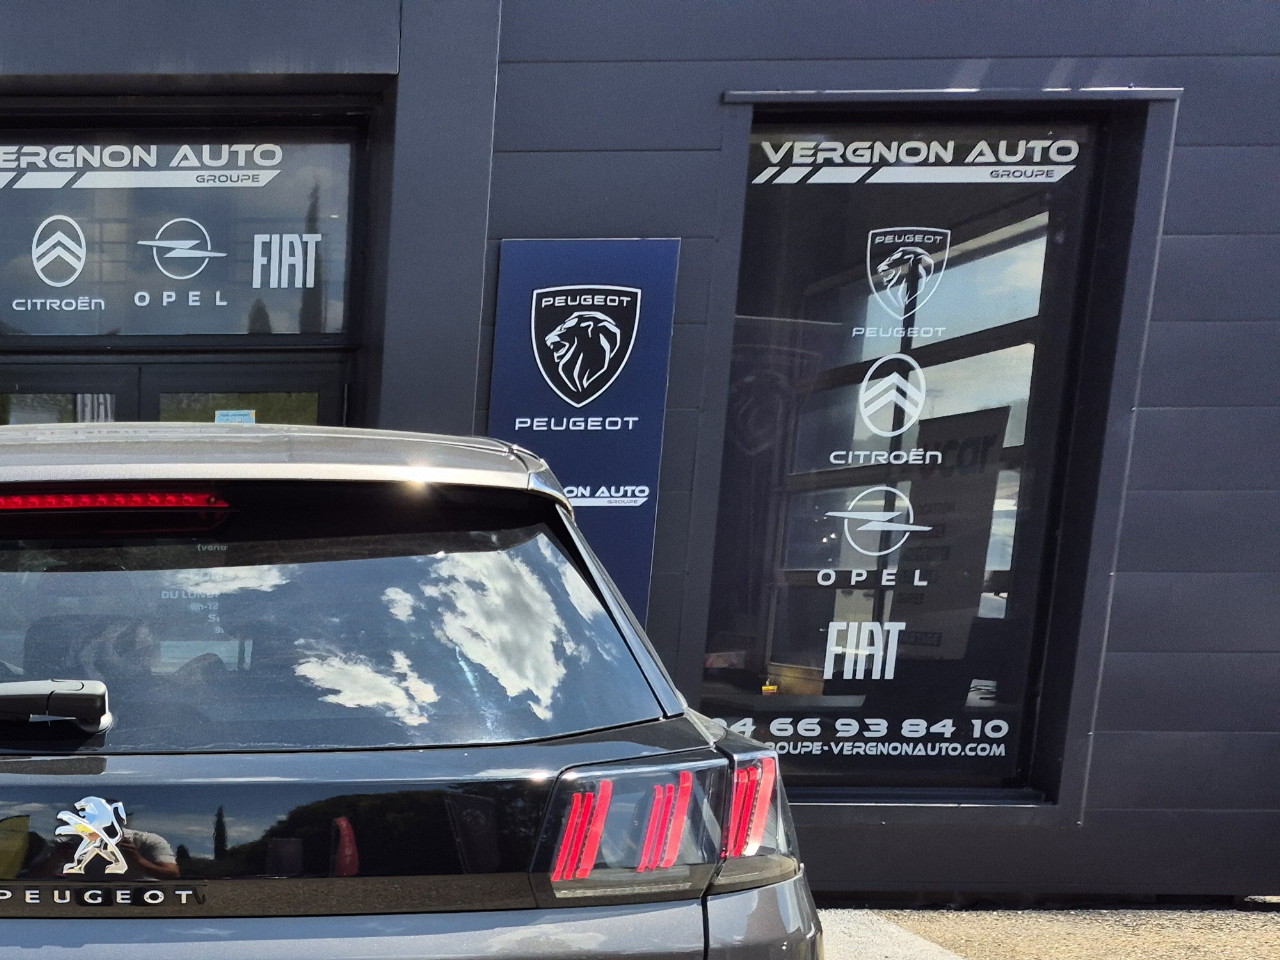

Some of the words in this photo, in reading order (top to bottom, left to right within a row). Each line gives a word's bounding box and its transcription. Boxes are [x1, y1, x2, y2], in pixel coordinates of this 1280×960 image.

[168, 143, 283, 168] AUTO
[761, 140, 955, 165] VERGNON
[964, 139, 1080, 163] AUTO
[195, 173, 262, 184] GROUPE
[989, 169, 1056, 179] GROUPE
[874, 234, 944, 245] PEUGEOT
[252, 233, 322, 289] FIAT
[134, 291, 228, 307] OPEL
[541, 295, 631, 308] PEUGEOT
[852, 327, 947, 338] PEUGEOT
[515, 416, 639, 431] PEUGEOT
[594, 485, 650, 498] AUTO
[816, 569, 929, 586] OPEL
[823, 621, 907, 680] FIAT
[769, 717, 822, 737] 66
[835, 718, 888, 738] 93
[901, 718, 957, 738] 84
[971, 719, 1010, 739] 10
